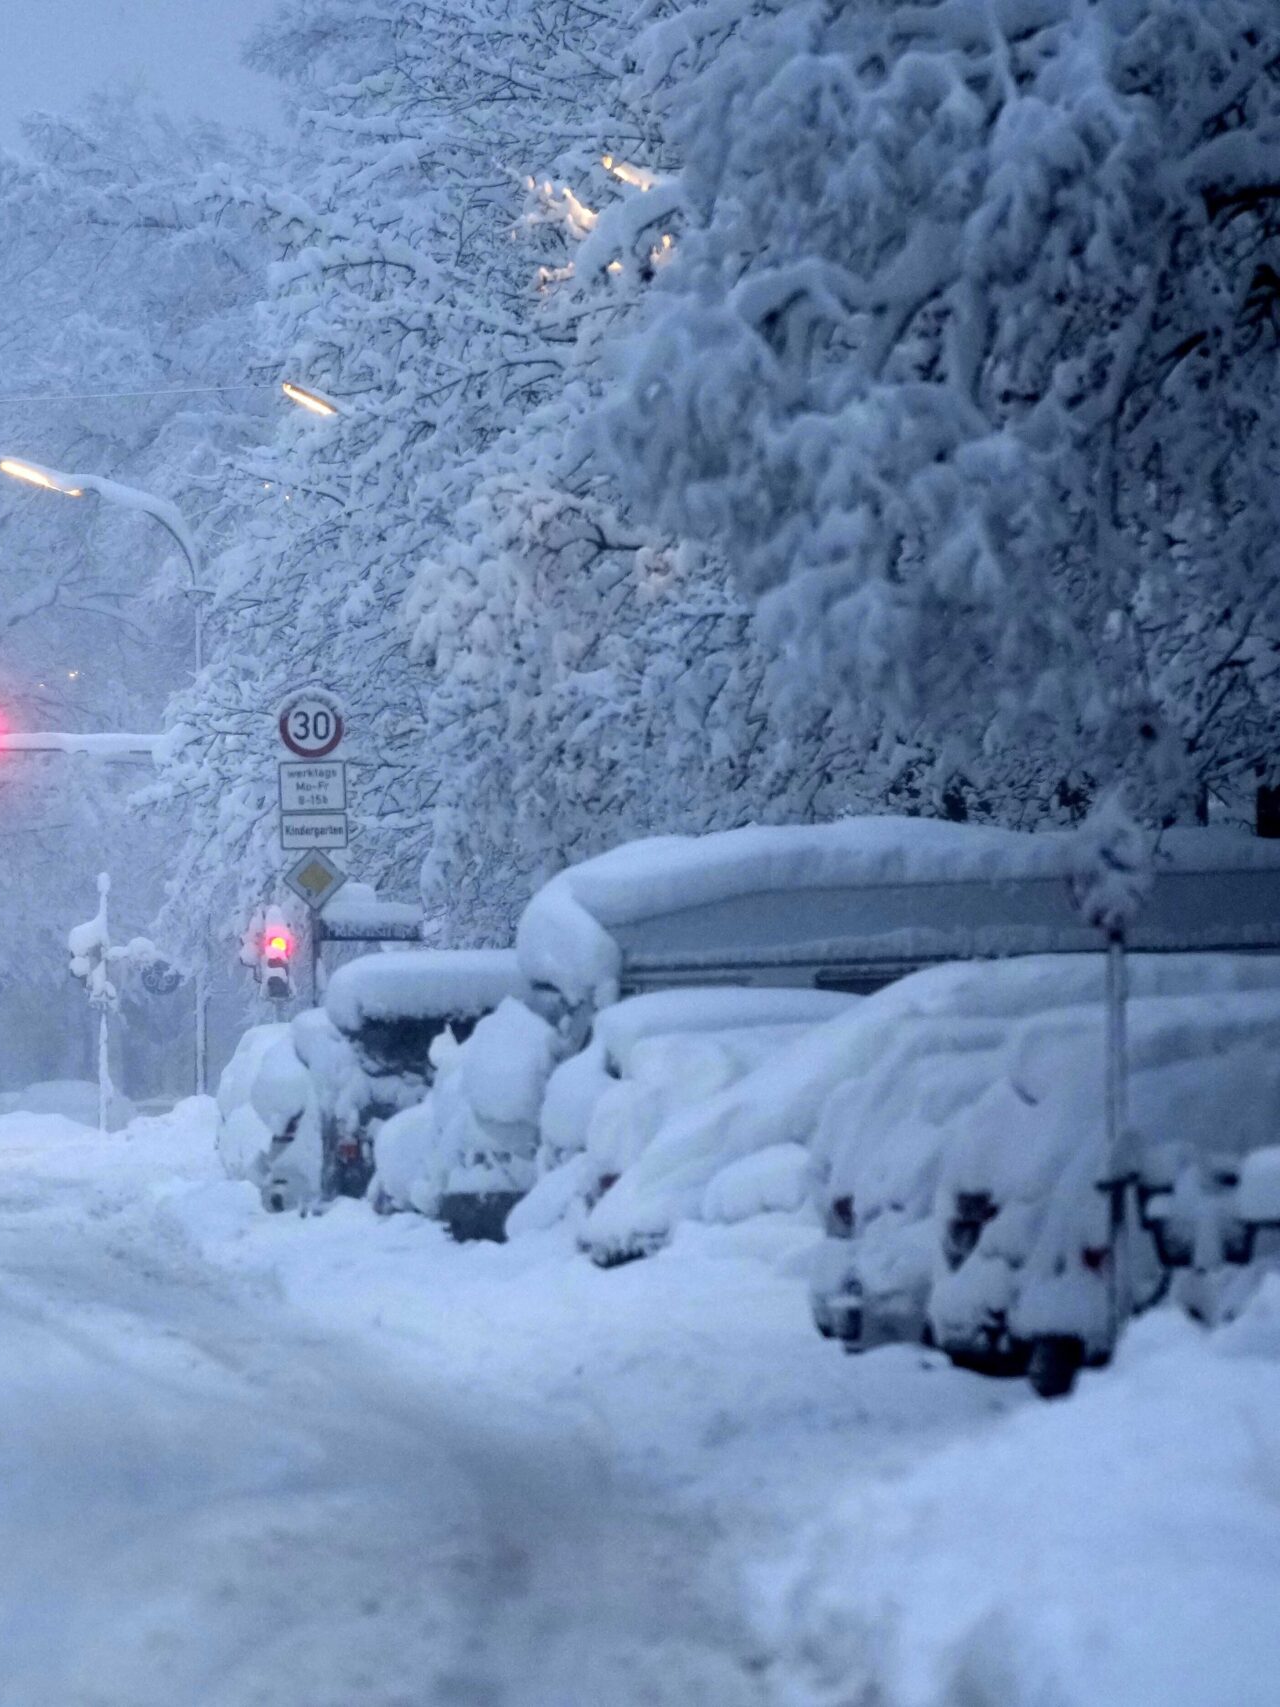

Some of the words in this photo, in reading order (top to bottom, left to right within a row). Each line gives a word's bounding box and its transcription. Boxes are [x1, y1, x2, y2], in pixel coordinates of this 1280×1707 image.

[293, 711, 330, 740] 30
[287, 768, 337, 779] werktags
[285, 825, 344, 839] Kindergarten
